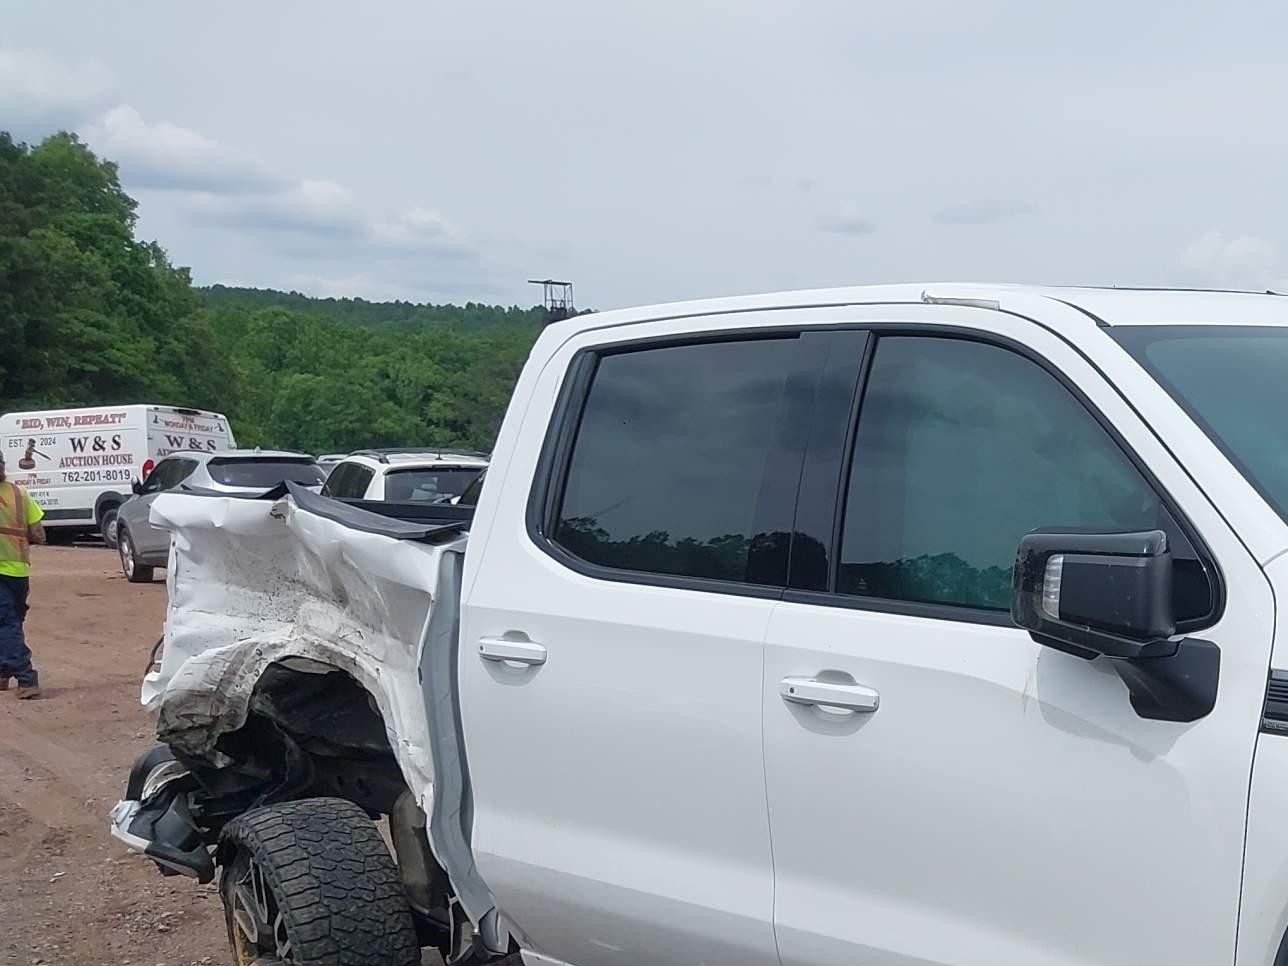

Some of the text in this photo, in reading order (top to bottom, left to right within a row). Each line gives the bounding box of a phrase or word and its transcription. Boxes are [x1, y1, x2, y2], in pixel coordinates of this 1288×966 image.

[46, 416, 71, 429] WIN,
[8, 436, 57, 448] EST. 2024
[69, 434, 122, 453] W & S
[164, 434, 217, 451] W & S
[59, 454, 133, 468] AUCTION HOUSE
[62, 469, 131, 483] 762-201-8019
